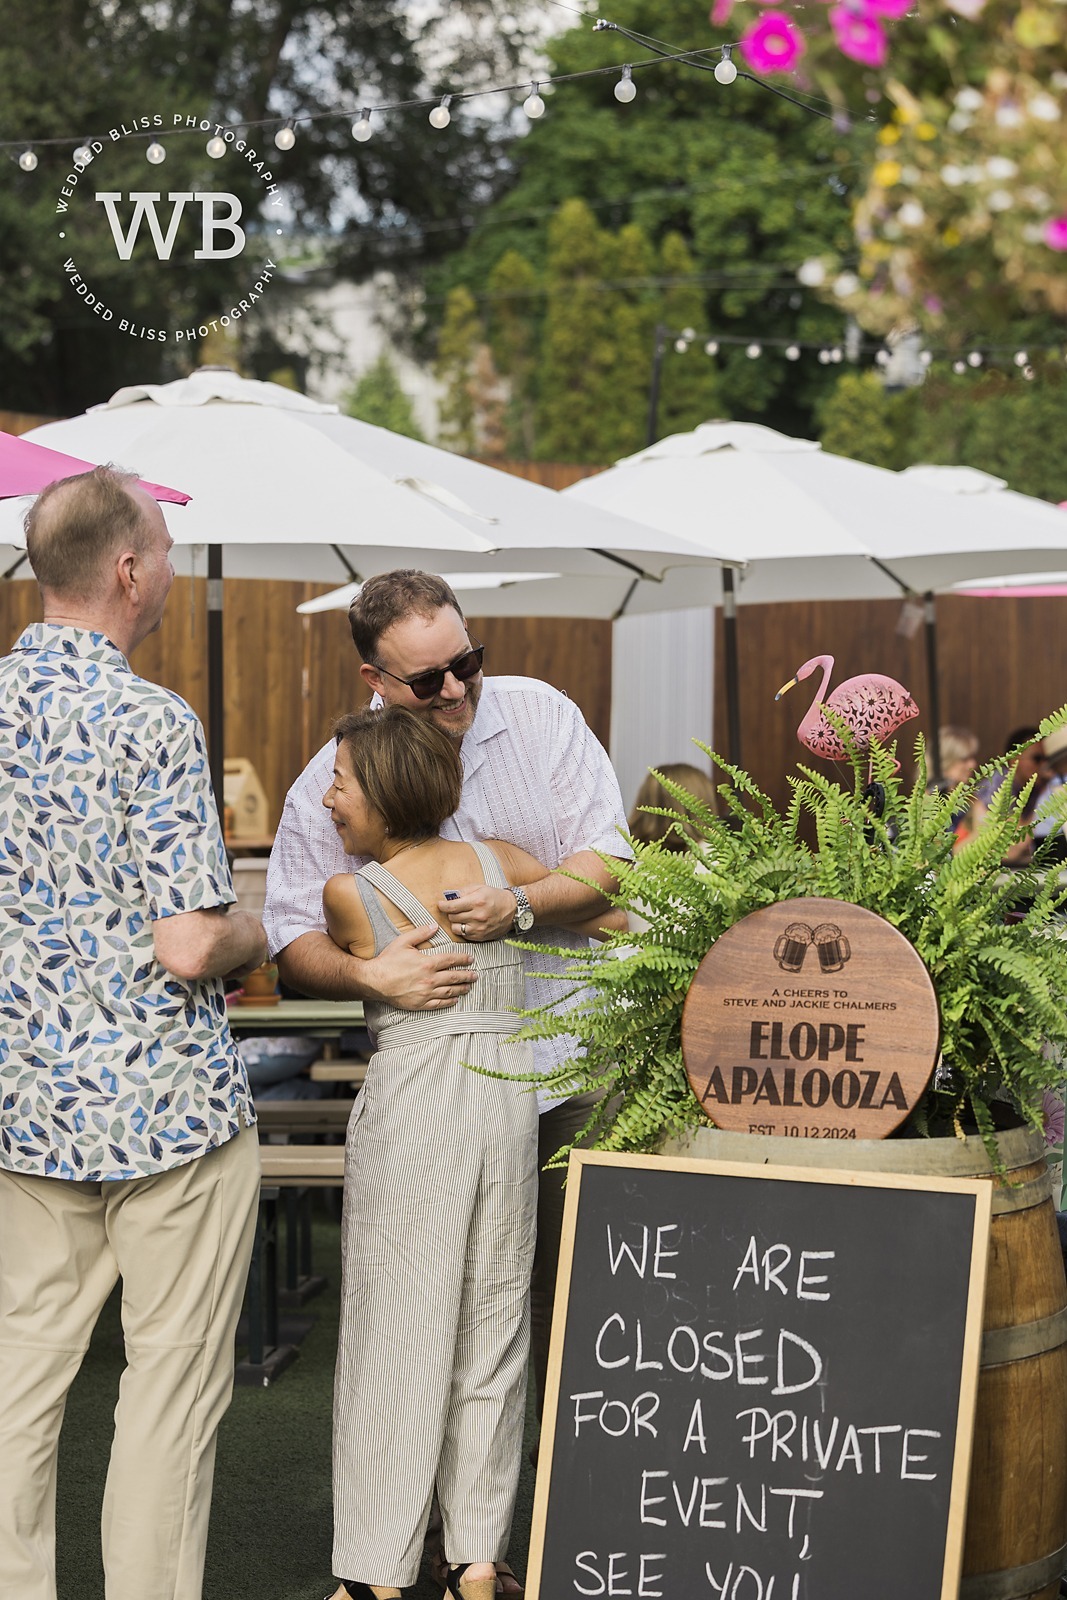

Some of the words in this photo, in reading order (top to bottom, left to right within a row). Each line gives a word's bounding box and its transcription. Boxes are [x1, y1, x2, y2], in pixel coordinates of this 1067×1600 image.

[723, 998, 759, 1008] STEVE
[762, 999, 787, 1009] AND
[789, 1000, 830, 1010] JACKIE
[833, 1001, 897, 1011] CHALMERS
[771, 988, 780, 997] A
[783, 988, 830, 998] CHEERS
[833, 989, 848, 999] TO
[750, 1021, 866, 1062] ELOPE
[702, 1066, 908, 1110] APALOOZA
[606, 1223, 680, 1280] WE
[732, 1235, 836, 1302] ARE
[594, 1311, 823, 1396] CLOSED
[569, 1390, 661, 1440] FOR
[682, 1397, 708, 1455] A
[735, 1406, 943, 1482] PRIVATE
[572, 1550, 668, 1598] SEE
